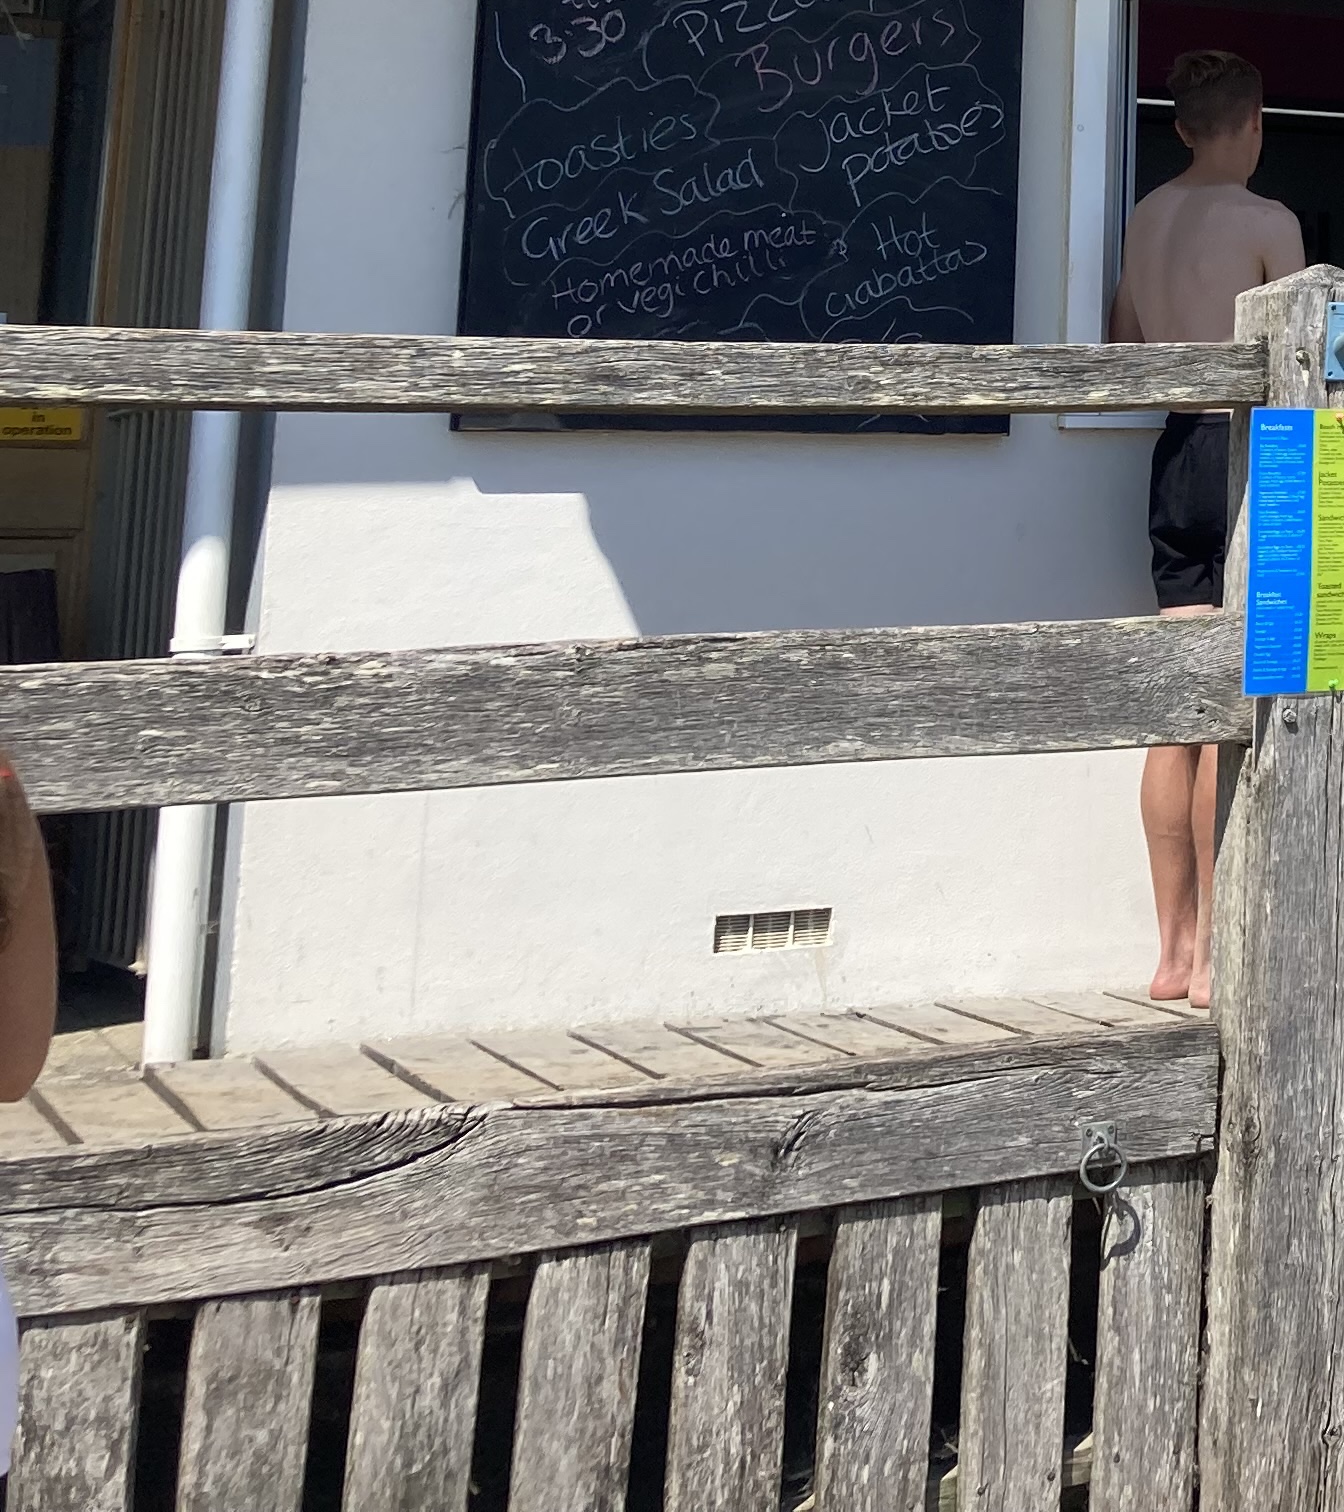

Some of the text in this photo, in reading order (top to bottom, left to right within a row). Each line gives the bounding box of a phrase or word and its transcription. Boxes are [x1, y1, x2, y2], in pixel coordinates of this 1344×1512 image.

[734, 9, 957, 114] Burgers
[520, 190, 651, 262] Greek
[870, 210, 940, 261] Hot
[551, 222, 816, 313] Homemade meat
[566, 302, 607, 339] or
[616, 281, 688, 319] vegi
[2, 425, 73, 437] operation
[31, 411, 46, 423] in
